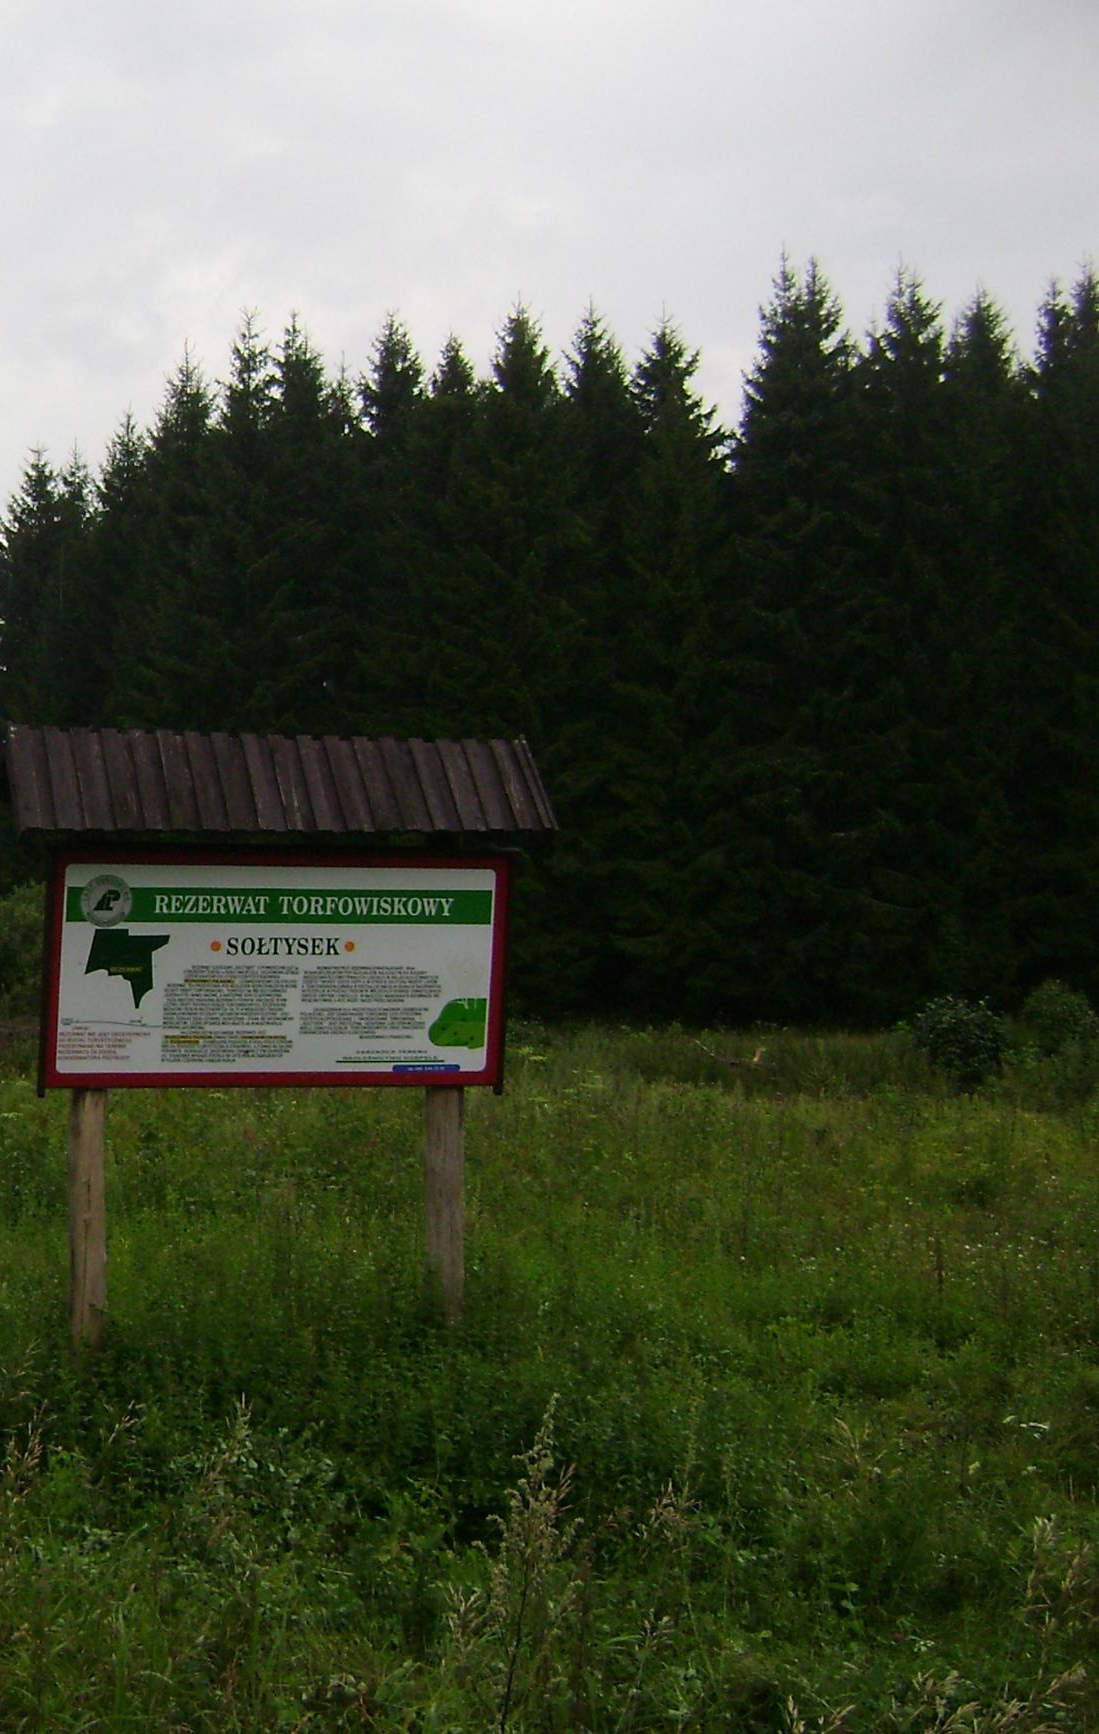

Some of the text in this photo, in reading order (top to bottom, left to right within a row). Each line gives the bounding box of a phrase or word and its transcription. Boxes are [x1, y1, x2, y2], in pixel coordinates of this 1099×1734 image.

[154, 895, 454, 917] REZERWAT TORFOWISKOWY
[226, 936, 341, 956] SOŁTYSEK
